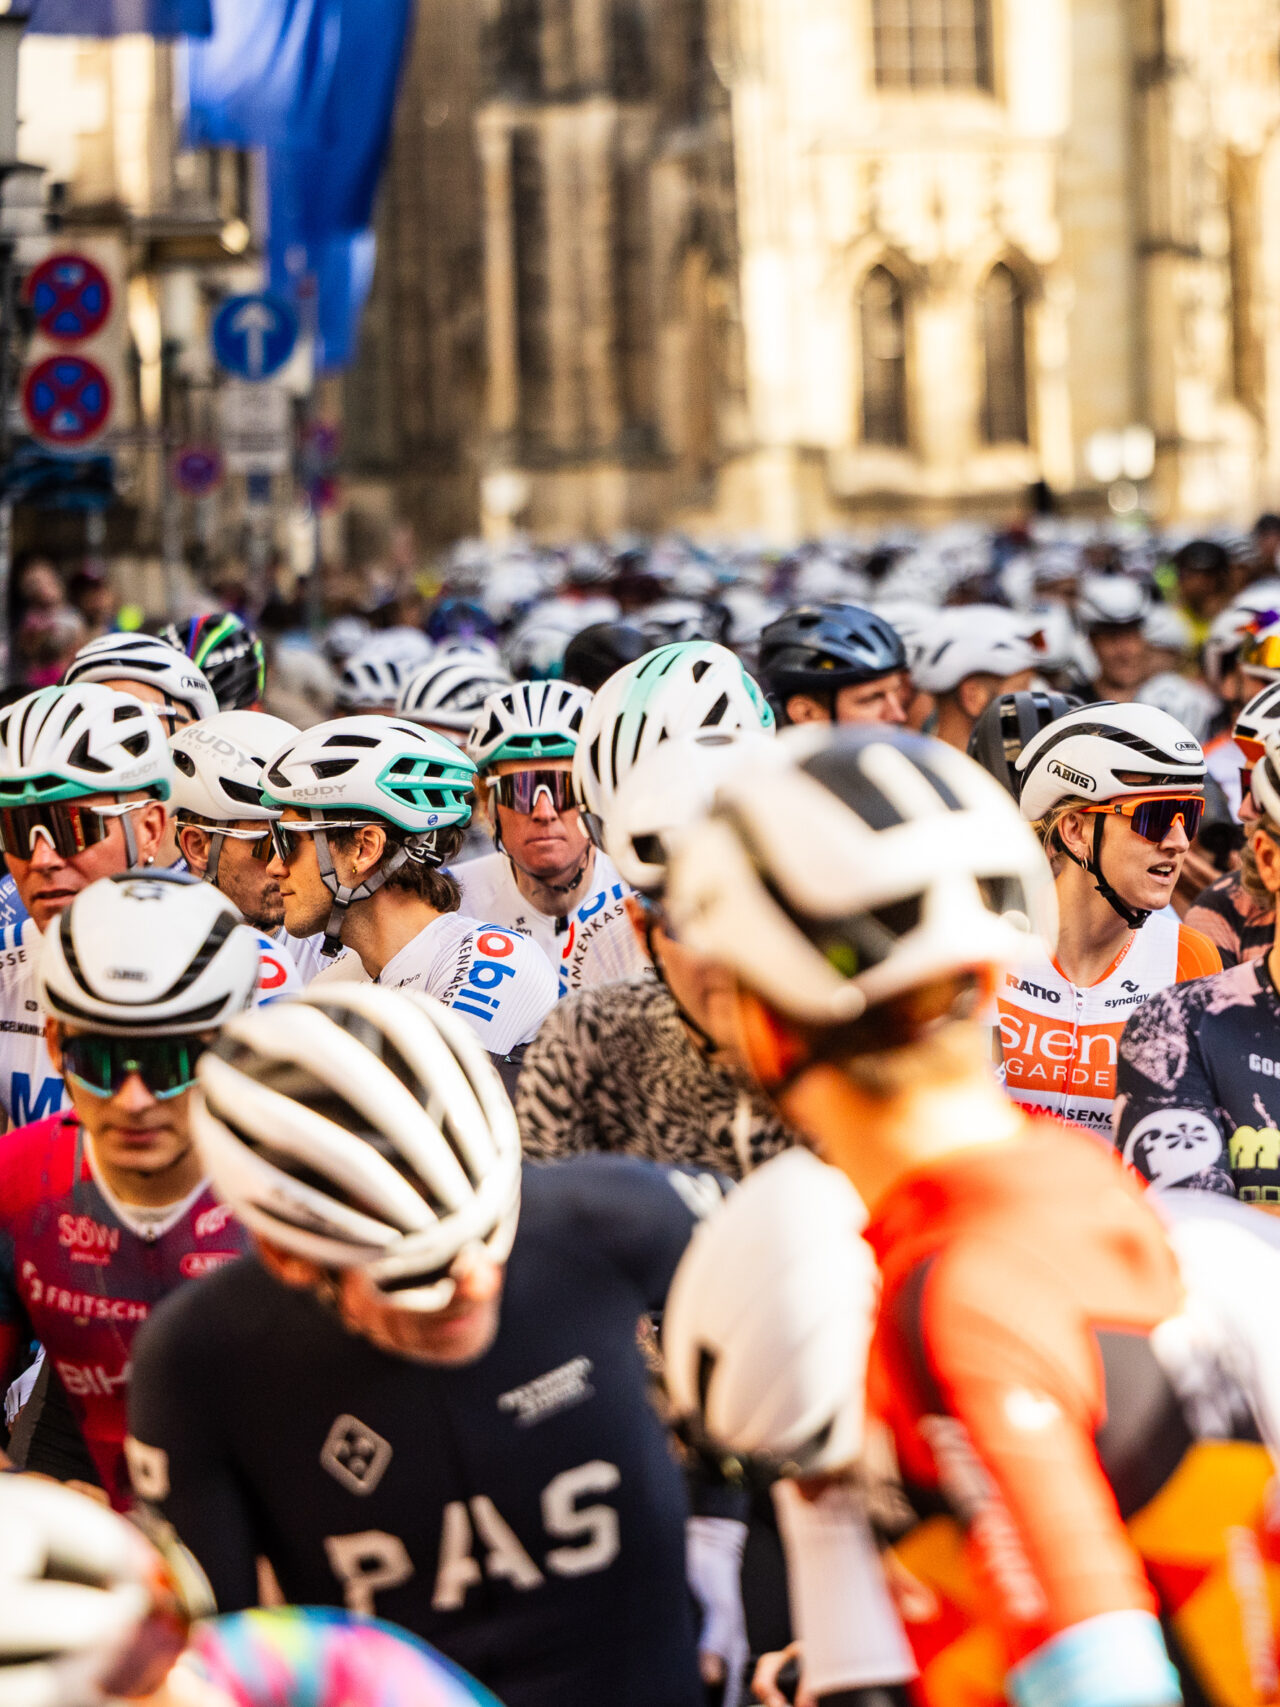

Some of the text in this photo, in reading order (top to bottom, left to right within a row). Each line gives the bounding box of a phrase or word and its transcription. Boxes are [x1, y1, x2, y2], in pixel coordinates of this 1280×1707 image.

[183, 728, 256, 769] RUDY
[292, 784, 347, 798] RUDY
[1052, 764, 1090, 790] ABUS
[454, 923, 516, 1022] obil
[1006, 973, 1060, 1004] RATIO
[1005, 1057, 1110, 1087] GARDE
[46, 1285, 148, 1320] FRITSCH
[322, 1459, 622, 1613] PAS
